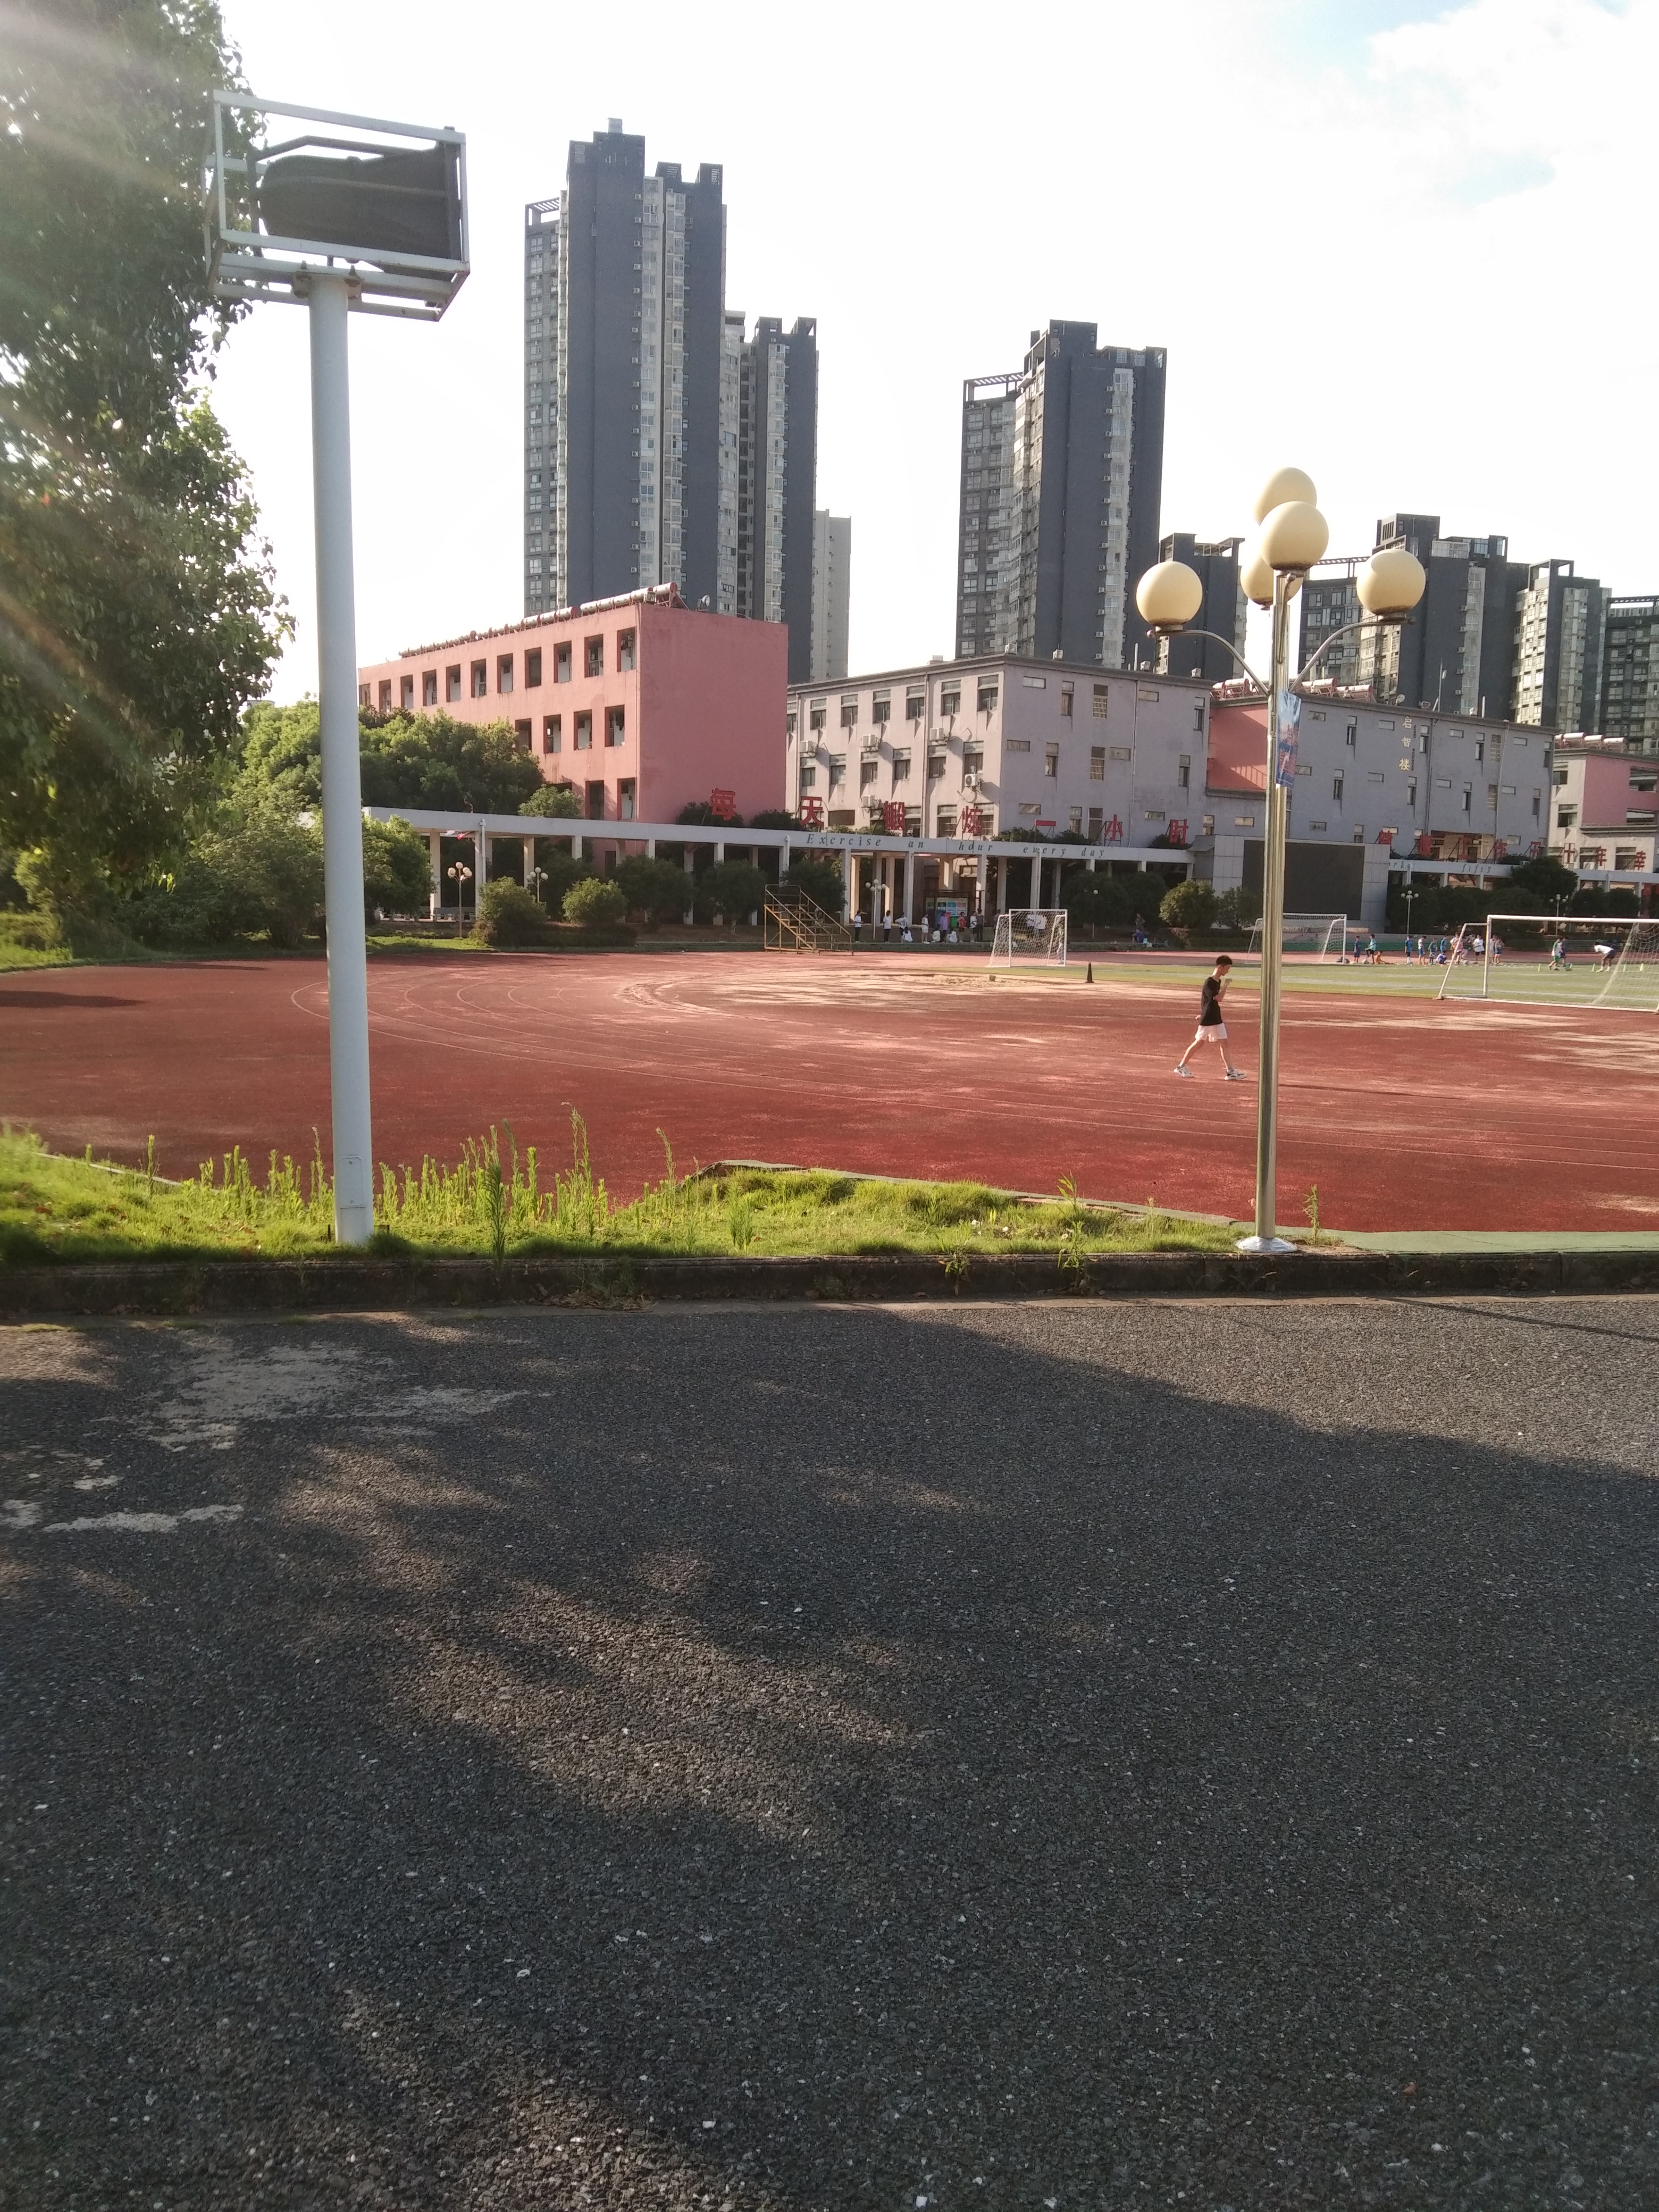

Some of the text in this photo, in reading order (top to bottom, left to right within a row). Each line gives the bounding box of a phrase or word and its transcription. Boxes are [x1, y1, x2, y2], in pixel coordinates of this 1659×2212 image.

[1398, 716, 1412, 771] 启智楼
[806, 834, 881, 847] Exercise
[958, 841, 993, 852] hour
[1023, 847, 1066, 858] every
[1081, 848, 1104, 859] day
